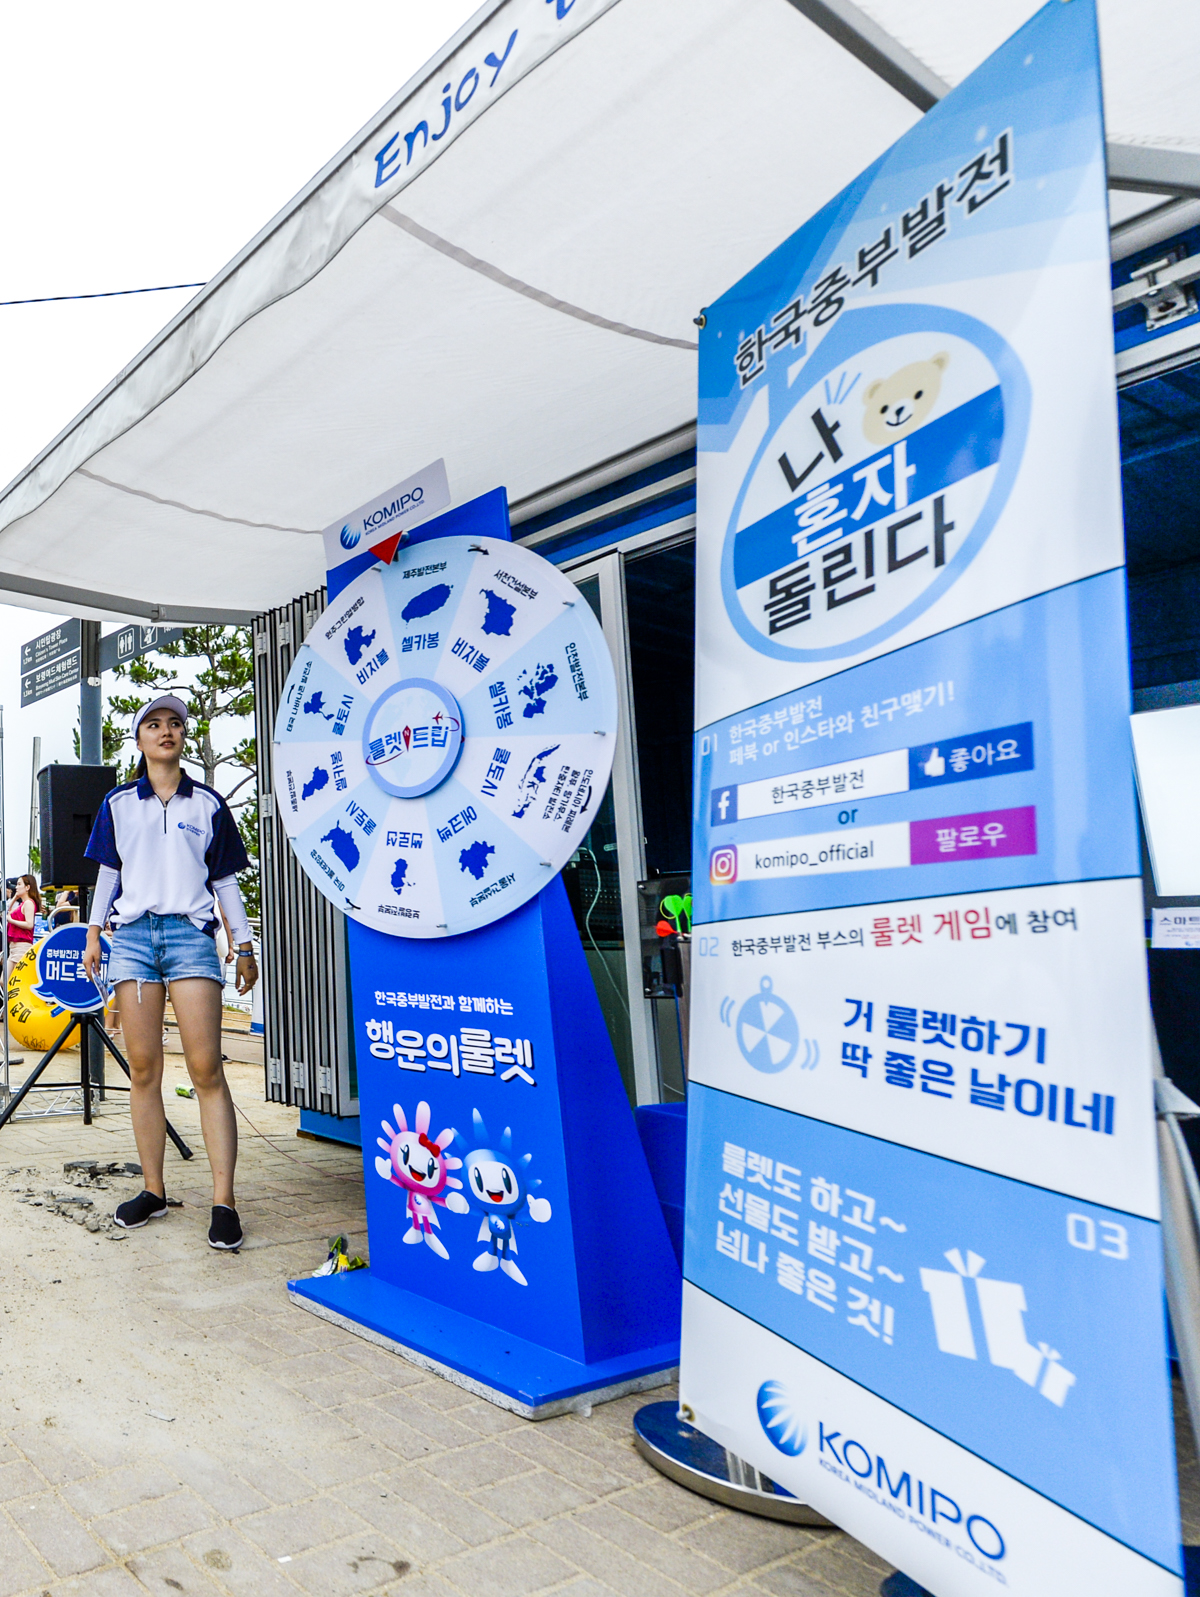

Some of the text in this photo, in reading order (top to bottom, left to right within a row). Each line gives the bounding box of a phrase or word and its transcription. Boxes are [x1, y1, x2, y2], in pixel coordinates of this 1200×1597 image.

[374, 28, 518, 188] Enjoy
[736, 130, 1012, 387] 한국중부발전
[777, 407, 844, 493] 나
[363, 487, 424, 531] KOMIPO
[791, 440, 917, 557] 혼자
[402, 561, 447, 581] 제주발전본부
[763, 494, 955, 636] 돌린다
[401, 632, 440, 653] 셀카봉
[451, 636, 489, 674] 비치볼
[356, 647, 390, 685] 비치볼
[568, 641, 589, 702] 인천발전본부
[286, 716, 295, 732] 태국
[301, 660, 313, 684] 발전소
[331, 694, 354, 736] 쿨토시
[488, 680, 514, 730] 셀카봉
[728, 694, 823, 745] 한국중부발전
[728, 741, 759, 766] 페북
[762, 742, 778, 757] or
[784, 714, 855, 751] 인스타와
[368, 731, 402, 761] 룰렛
[701, 733, 718, 757] 01
[948, 739, 1022, 773] 좋아요
[330, 750, 348, 791] 셀카봉
[481, 747, 512, 798] 쿨토시
[572, 769, 594, 808] 인도네시아
[771, 769, 865, 805] 한국중부발전
[345, 800, 377, 836] 쿨토시
[436, 805, 477, 844] 에코백
[542, 797, 557, 820] 발전소
[837, 805, 859, 826] or
[386, 830, 423, 849] 썬로션
[755, 841, 874, 871] komipo_official
[936, 823, 1007, 853] 팔로우
[333, 876, 346, 892] 미국
[468, 873, 517, 908] 서울건설본부
[699, 936, 719, 958] 02
[731, 906, 1079, 958] 한국중부발전 부스의 룰렛 게임에 참여
[46, 948, 79, 960] 중부발전과
[374, 990, 514, 1016] 한국중부발전과 함께하는
[365, 1018, 536, 1085] 행운의룰렛
[843, 998, 1047, 1065] 거 룰렛하기
[841, 1041, 1116, 1136] 딱 좋은 날이네
[722, 1141, 908, 1234] 룰렛도 하고~
[718, 1182, 905, 1284] 선물도 받고~
[1065, 1212, 1130, 1261] 03
[715, 1221, 895, 1346] 넘나 좋은 것!
[818, 1421, 1006, 1560] KOMIPO
[818, 1456, 851, 1485] KOREA
[854, 1479, 906, 1520] MIDLAND
[908, 1514, 951, 1548] POWER
